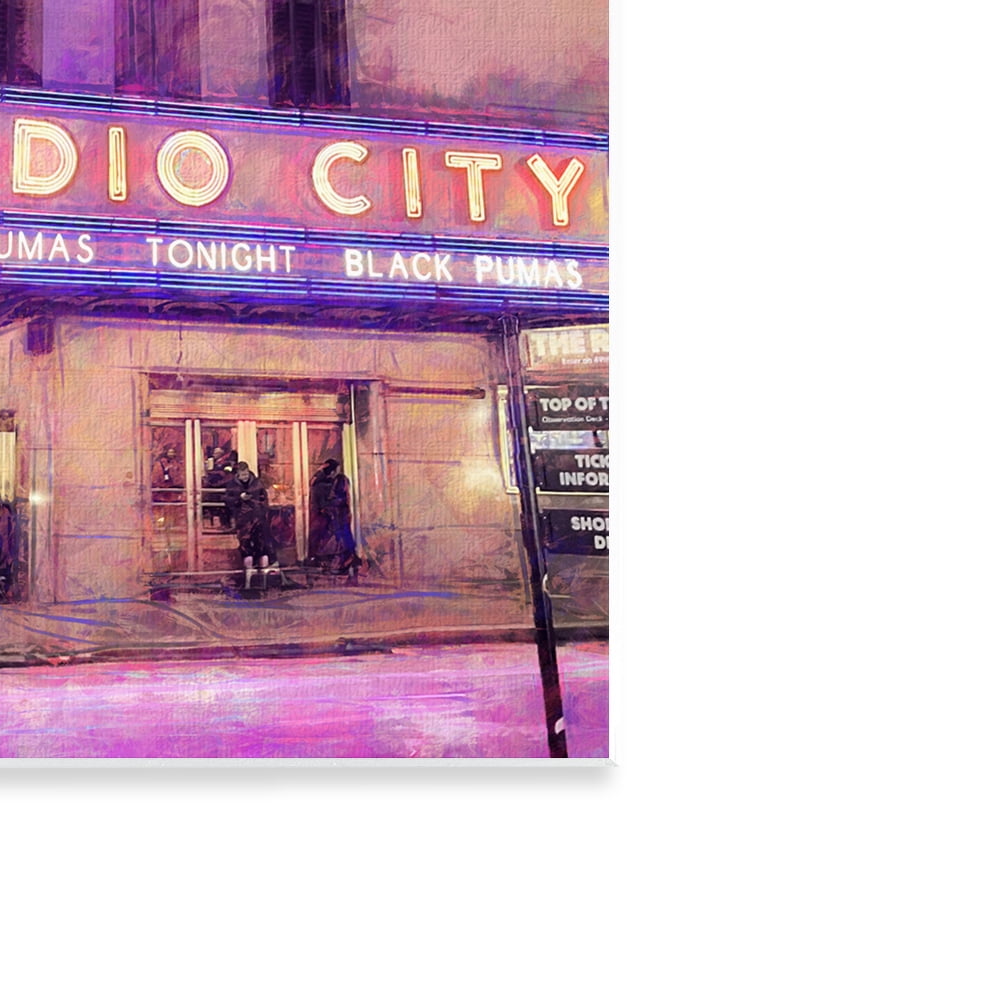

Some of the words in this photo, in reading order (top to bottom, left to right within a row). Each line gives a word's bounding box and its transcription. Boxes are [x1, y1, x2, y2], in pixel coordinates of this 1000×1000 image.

[312, 139, 587, 226] CITY
[146, 236, 296, 274] TONIGHT
[344, 248, 454, 283] BLACK
[474, 254, 583, 290] PUMAS
[539, 397, 573, 412] TOP
[574, 396, 597, 411] OF
